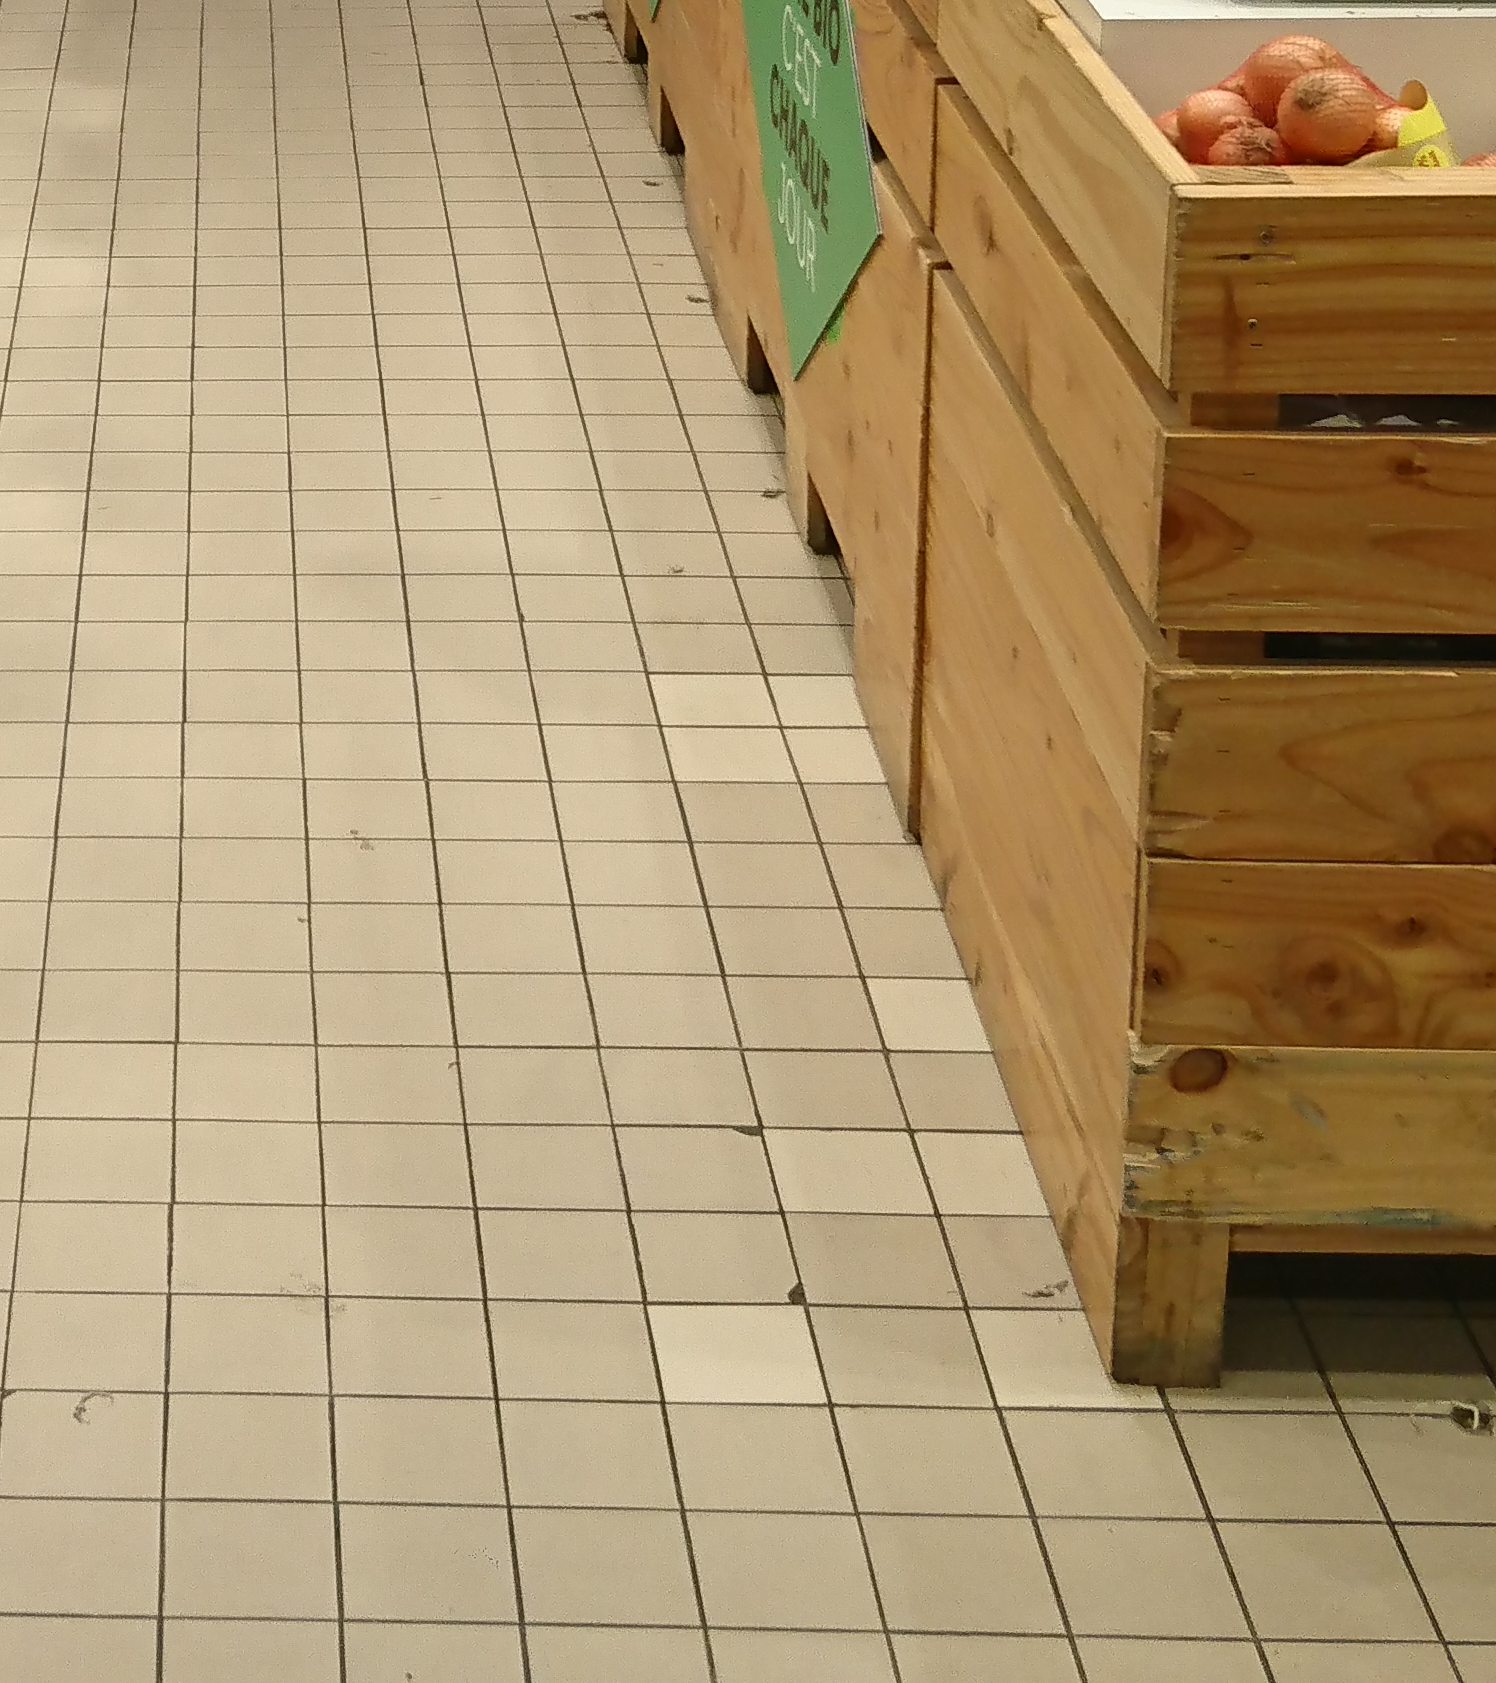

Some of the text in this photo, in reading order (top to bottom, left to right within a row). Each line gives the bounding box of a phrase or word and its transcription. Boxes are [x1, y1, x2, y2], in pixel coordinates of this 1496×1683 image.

[781, 3, 822, 118] C'EST
[769, 63, 833, 234] CHAQUE
[776, 161, 817, 294] JOUR
